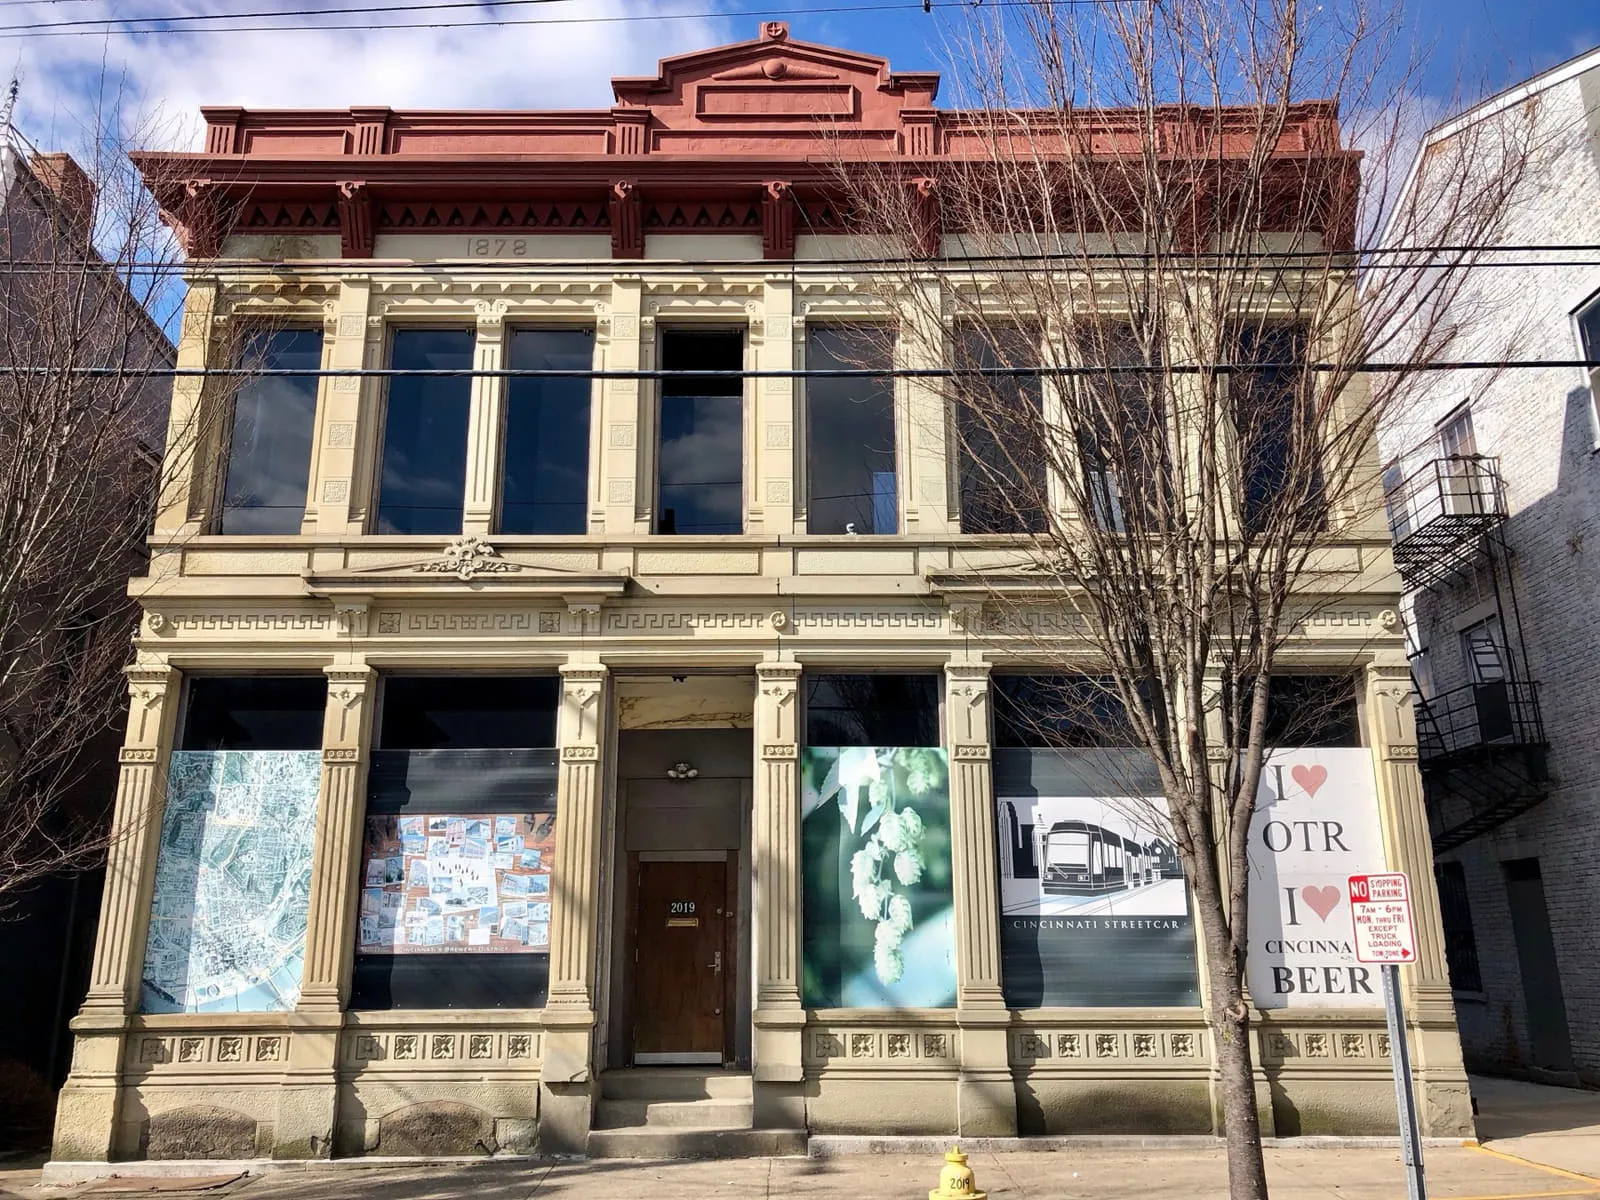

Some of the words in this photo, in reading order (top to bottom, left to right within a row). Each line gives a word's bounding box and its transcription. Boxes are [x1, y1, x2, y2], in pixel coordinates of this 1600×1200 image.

[466, 238, 527, 257] 1878
[1270, 764, 1289, 801] I
[1262, 820, 1352, 853] OTR
[1350, 881, 1367, 898] NO
[1370, 879, 1403, 889] STOPPING
[1372, 889, 1403, 899] PARKING
[670, 902, 696, 914] 2019
[1283, 887, 1301, 926] I
[1359, 904, 1376, 913] 7AM
[1385, 904, 1403, 914] 6PM
[1013, 920, 1097, 929] CINCINNATI
[1104, 919, 1179, 929] STREETCAR
[1376, 916, 1391, 924] THRU
[1368, 924, 1398, 933] EXCEPT
[1370, 932, 1397, 940] TRUCK
[1264, 940, 1354, 954] CINCINNA
[1368, 940, 1402, 948] LOADING
[1270, 966, 1375, 994] BEER
[950, 1177, 970, 1190] 2019
